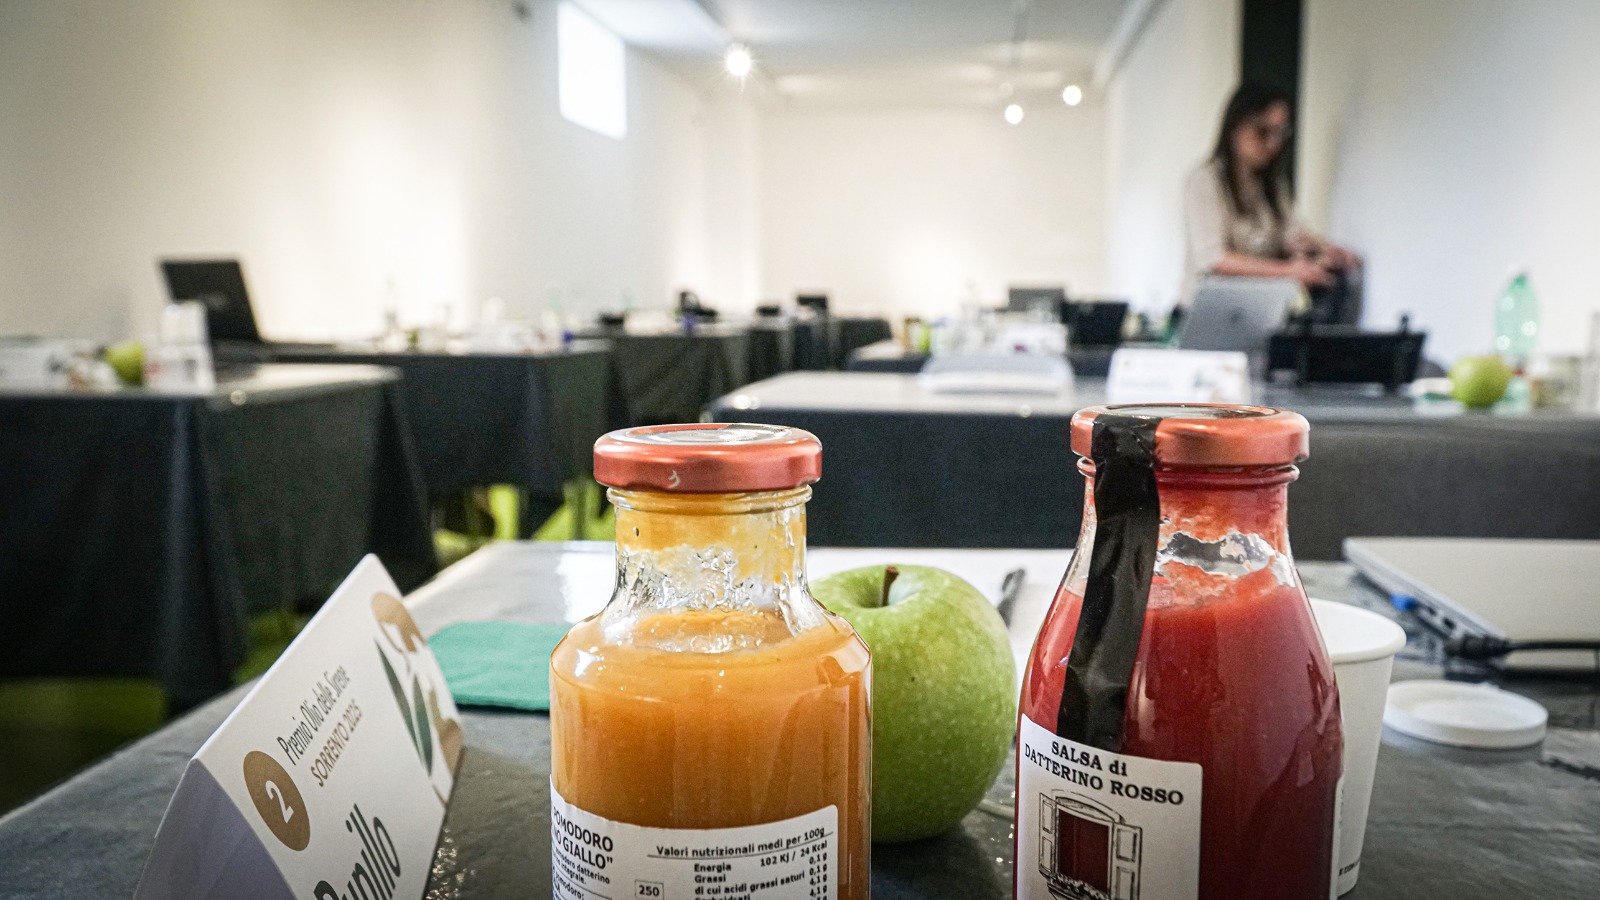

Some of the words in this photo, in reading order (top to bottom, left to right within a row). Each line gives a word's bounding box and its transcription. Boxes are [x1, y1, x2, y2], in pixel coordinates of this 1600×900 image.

[277, 716, 313, 766] Premio
[310, 722, 349, 787] SORRENTO
[1051, 741, 1103, 771] SALSA
[1109, 760, 1128, 777] di
[1025, 743, 1104, 791] DATTERINO
[1110, 780, 1184, 805] ROSSO
[264, 780, 294, 824] 2
[563, 837, 613, 869] GIALLO"
[656, 846, 689, 857] Valori
[692, 843, 755, 857] nutrizionali
[757, 838, 783, 851] medi
[786, 836, 801, 849] per
[577, 864, 610, 884] datterino
[694, 862, 731, 873] Energia
[760, 856, 777, 867] 102
[695, 873, 726, 883] Grassi
[639, 885, 660, 897] 250
[695, 886, 704, 895] di
[707, 885, 721, 895] cui
[724, 883, 747, 893] acidi
[750, 877, 778, 893] grassi
[780, 870, 805, 885] saturi
